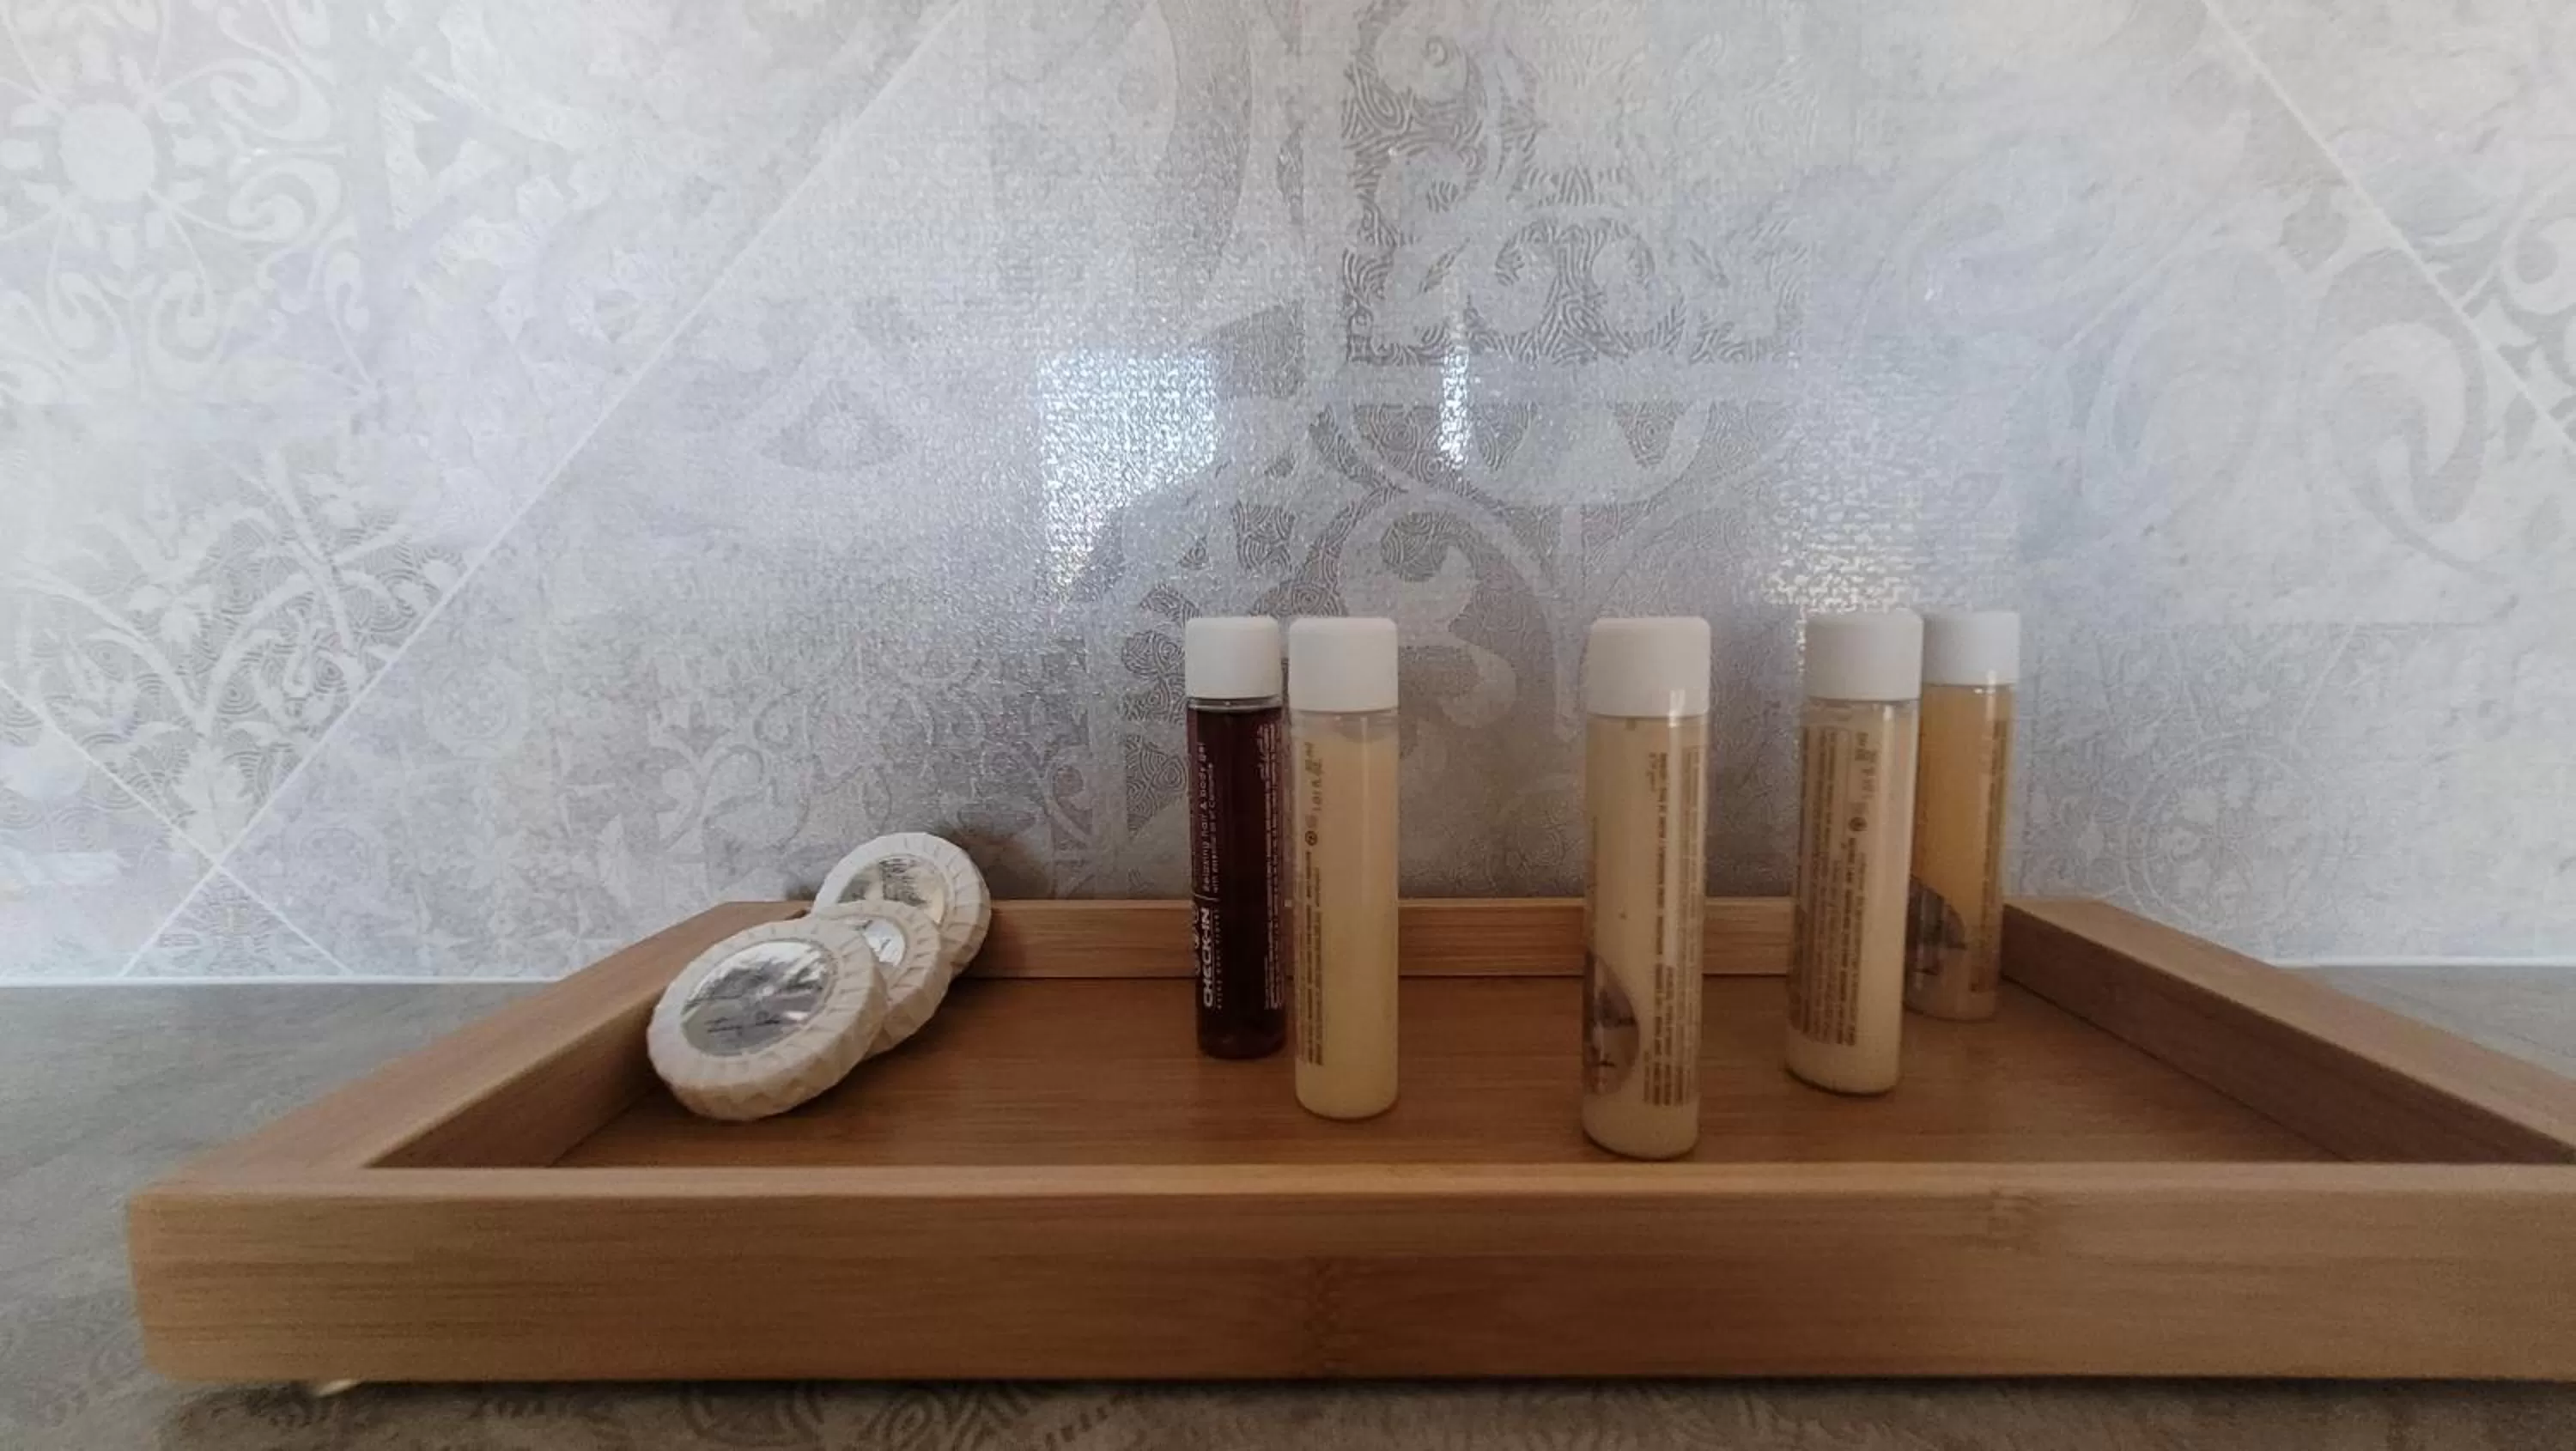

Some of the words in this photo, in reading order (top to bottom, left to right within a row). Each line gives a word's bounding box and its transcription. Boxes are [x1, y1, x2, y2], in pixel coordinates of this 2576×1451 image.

[1198, 742, 1206, 762] gel
[1198, 768, 1207, 798] body
[1200, 800, 1208, 810] &
[1201, 813, 1210, 838] hair
[1202, 841, 1211, 892] Relaxing
[1200, 906, 1214, 1008] CHECK-IN
